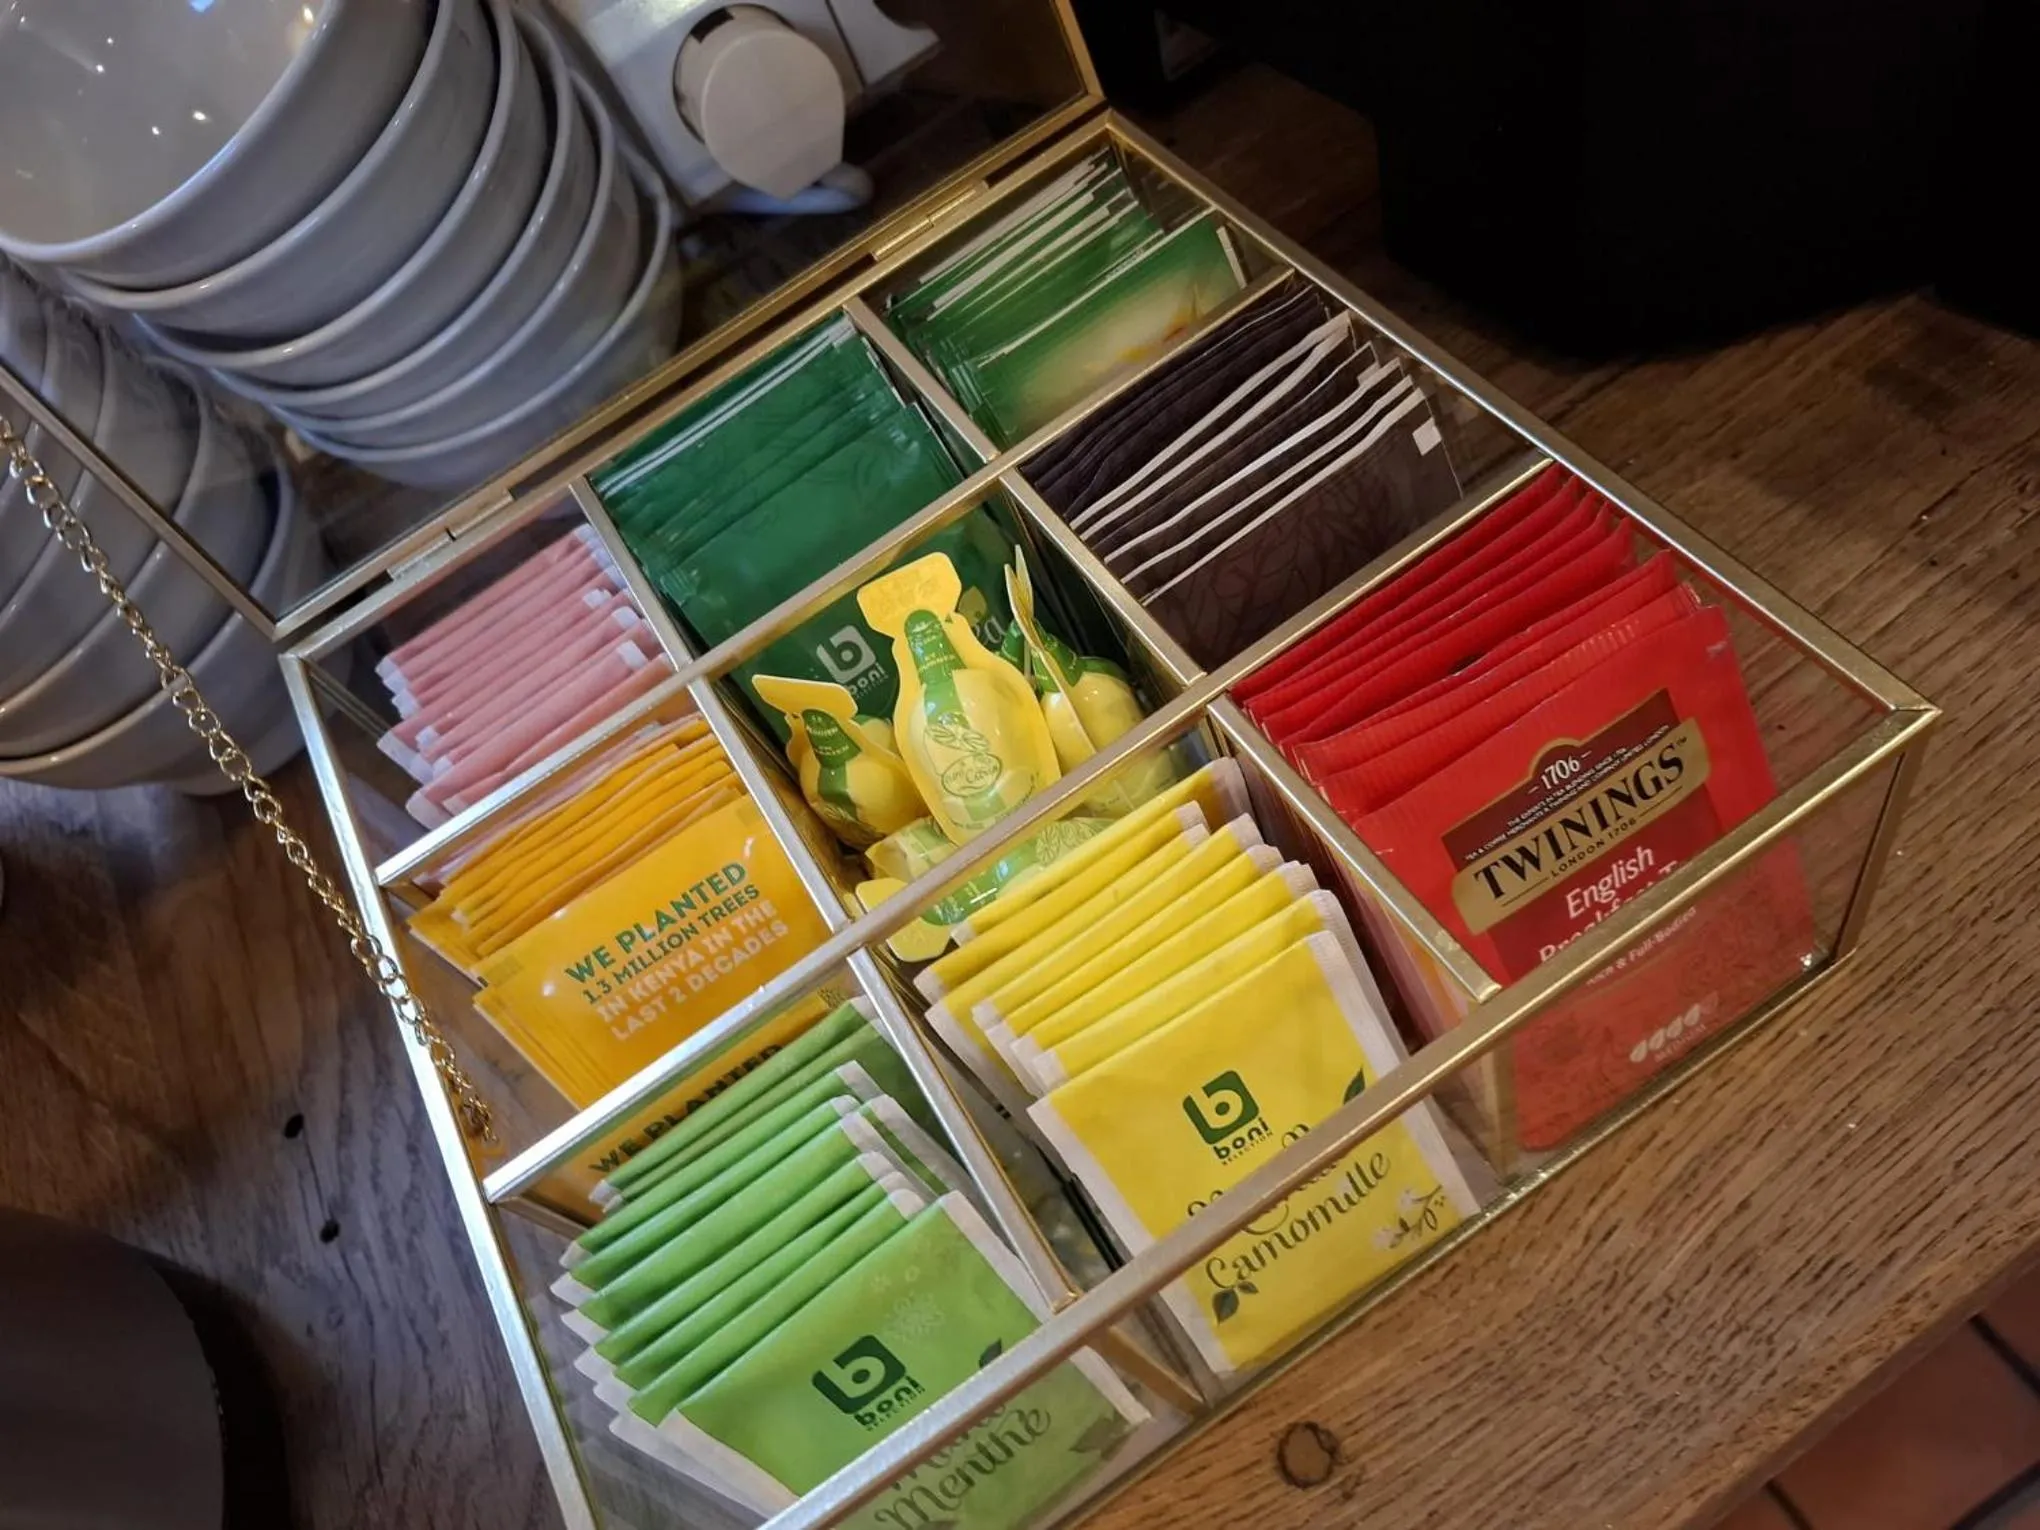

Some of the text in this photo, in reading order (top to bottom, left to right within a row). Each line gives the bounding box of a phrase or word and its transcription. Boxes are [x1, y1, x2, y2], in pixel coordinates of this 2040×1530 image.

[1473, 742, 1685, 899] TWININGS
[1541, 756, 1580, 790] 1706
[1551, 818, 1637, 878] LONDON 1706
[1566, 846, 1654, 920] English
[564, 862, 747, 984] WE PLANTED
[596, 900, 778, 1023] IN KENYA IN THE
[612, 922, 700, 985] MILLION
[698, 884, 760, 929] TREES
[611, 919, 789, 1041] LAST 2 DECADES
[1213, 1117, 1268, 1159] boni
[1206, 1152, 1391, 1289] Camomille
[854, 1375, 920, 1426] boni
[874, 1408, 1051, 1529] Menthe
